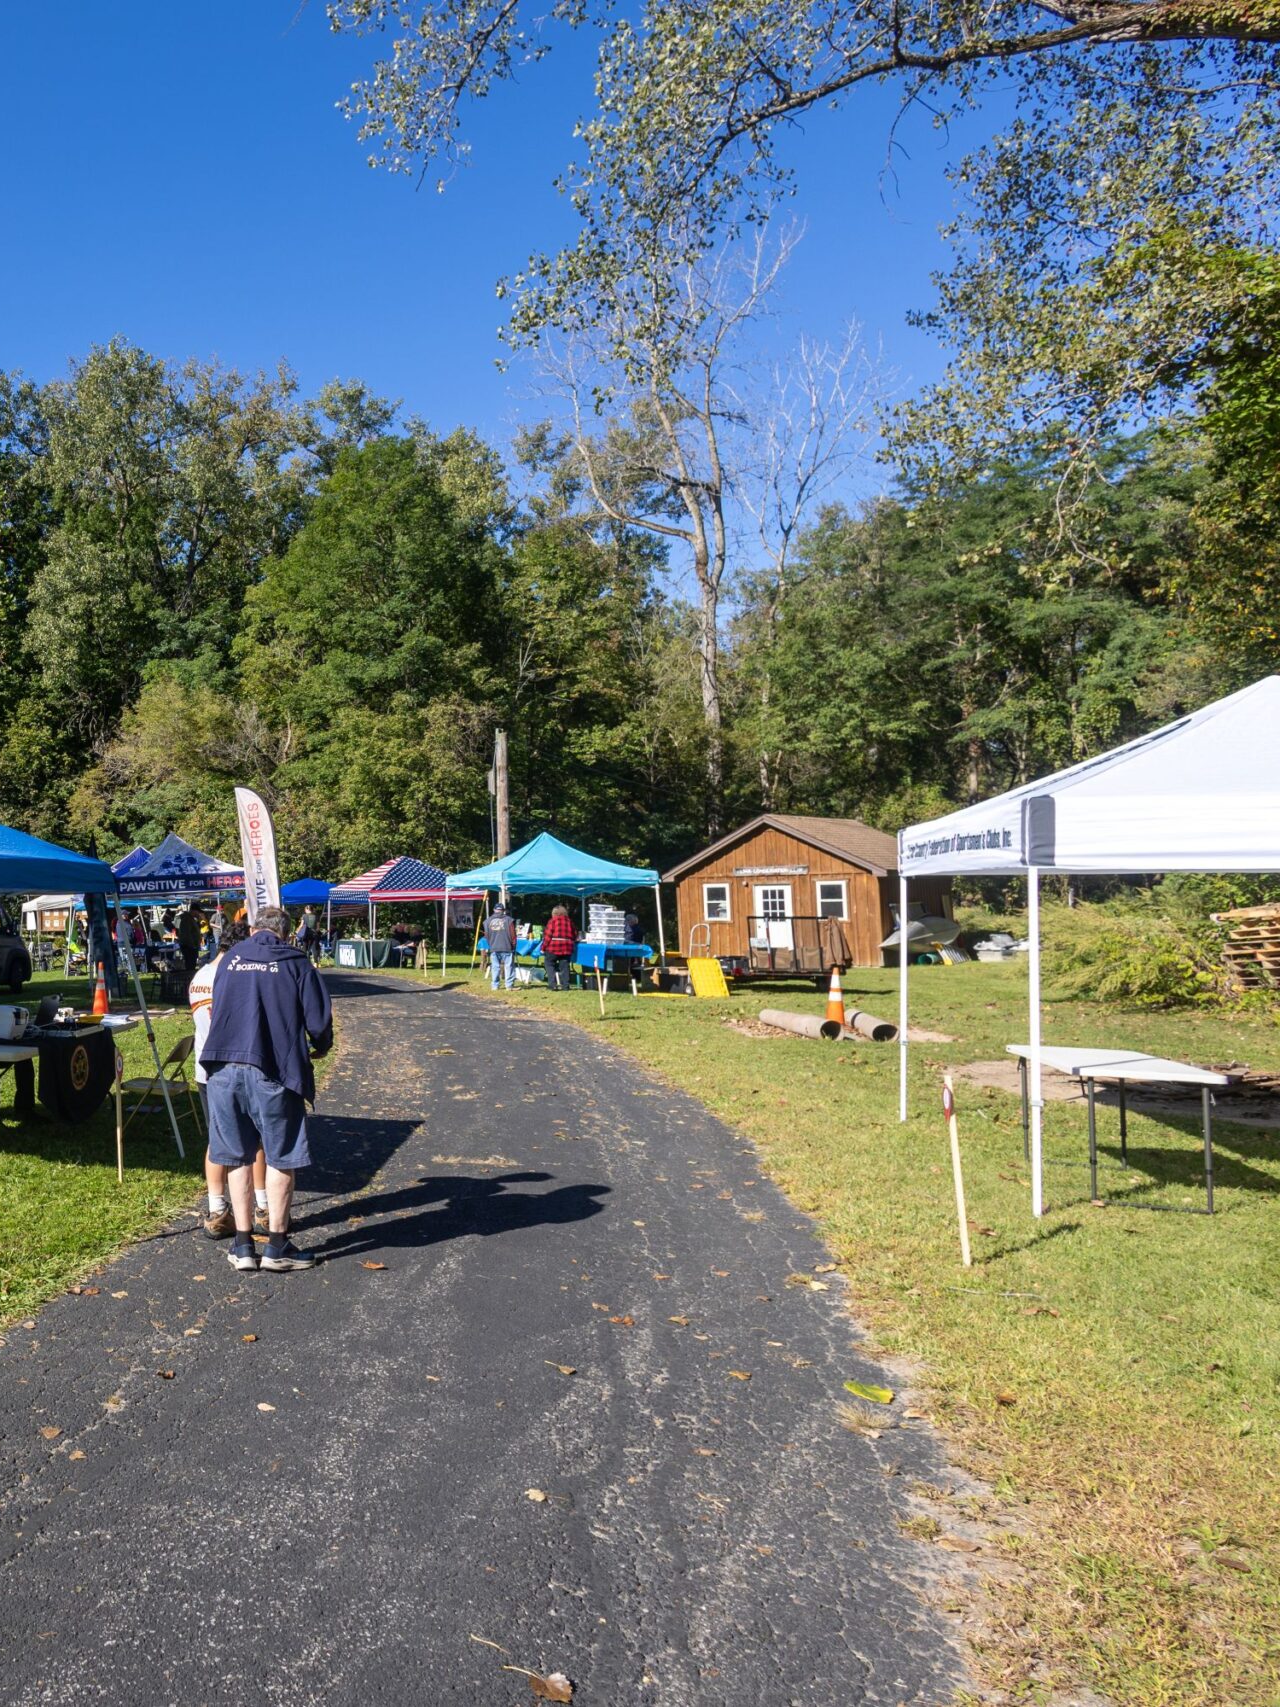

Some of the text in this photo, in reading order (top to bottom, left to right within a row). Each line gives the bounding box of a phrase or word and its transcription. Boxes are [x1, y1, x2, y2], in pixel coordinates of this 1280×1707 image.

[247, 802, 263, 857] HEROES
[120, 879, 186, 893] PAWSITIVE
[235, 964, 267, 972] BOXING
